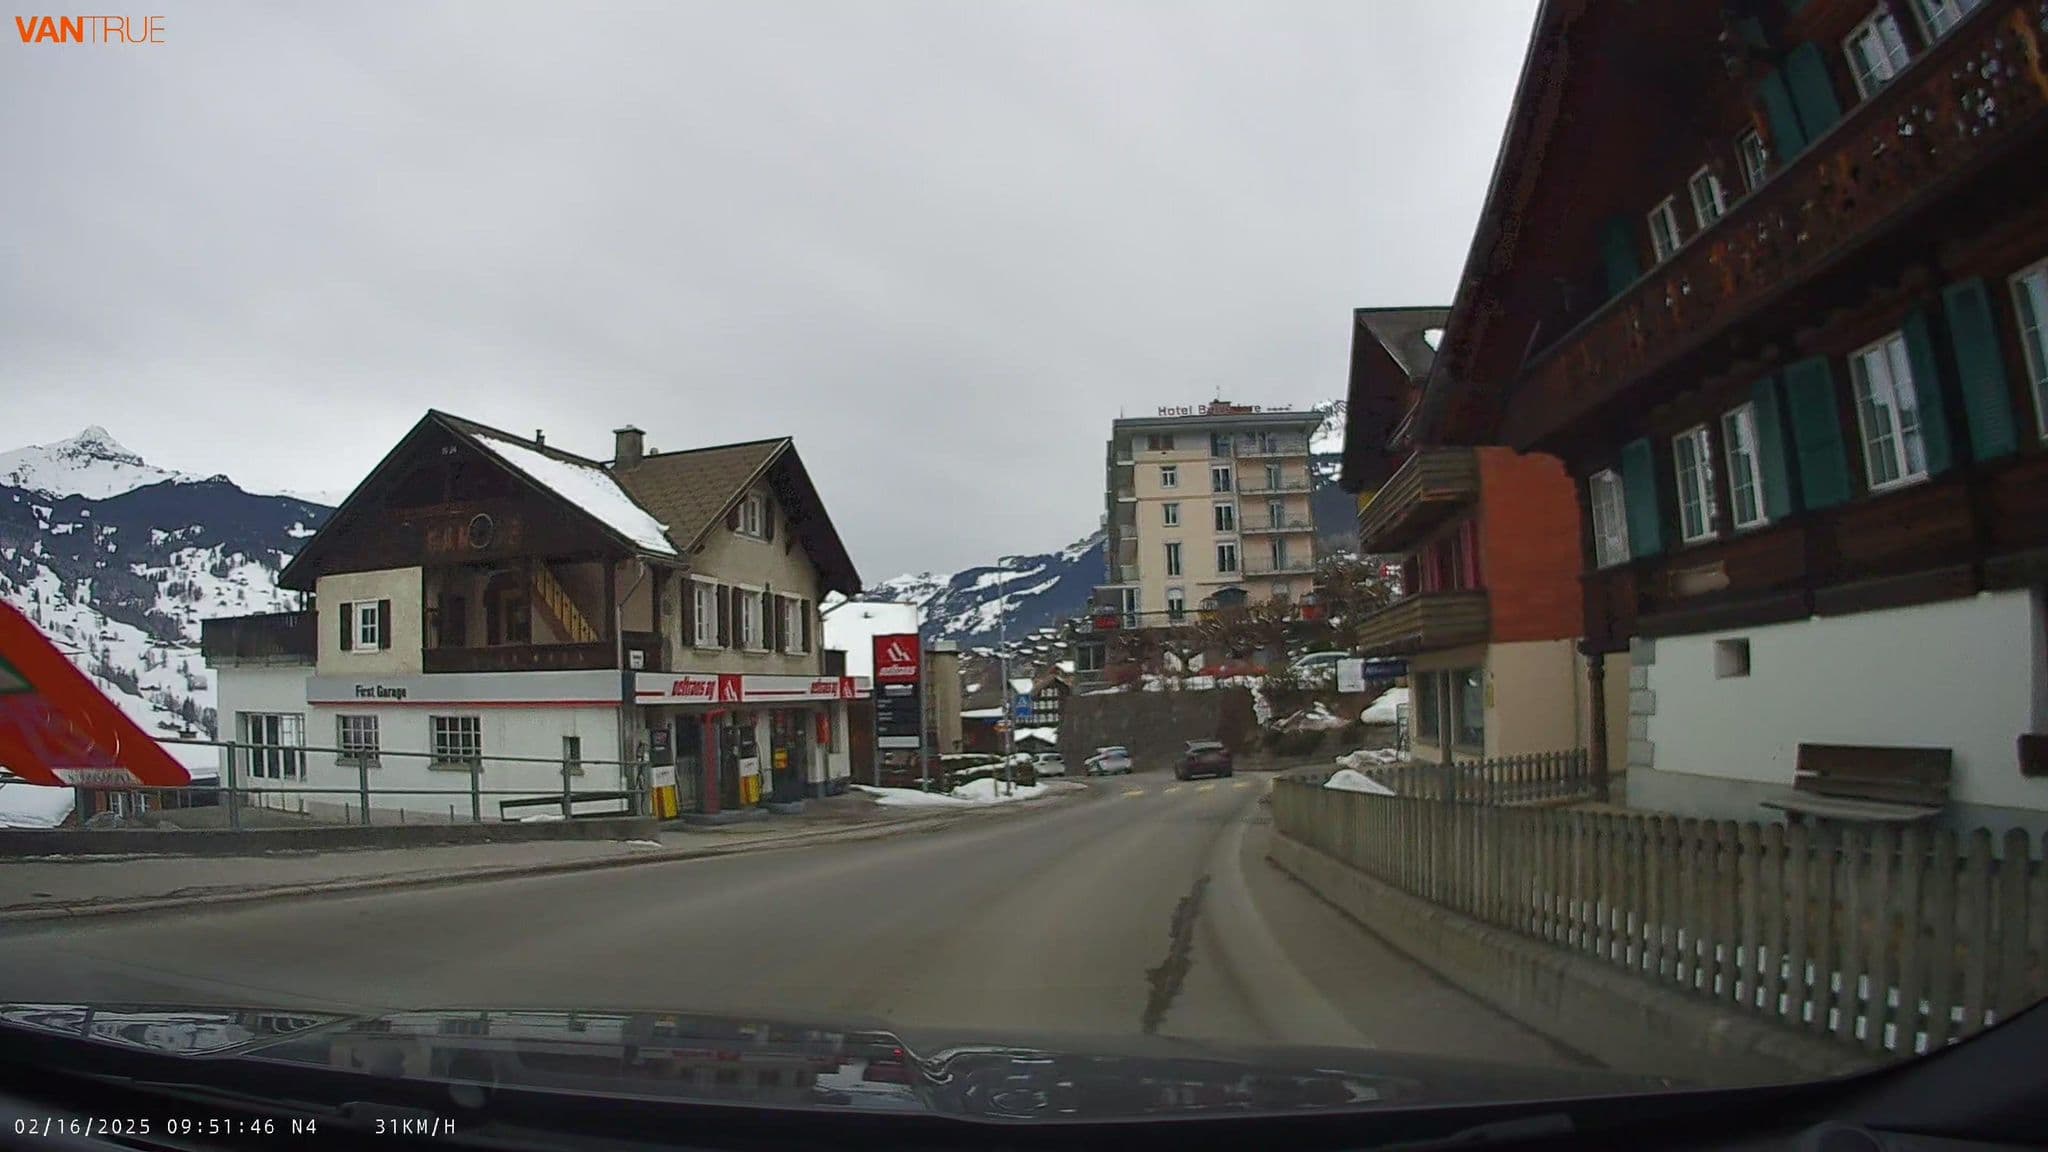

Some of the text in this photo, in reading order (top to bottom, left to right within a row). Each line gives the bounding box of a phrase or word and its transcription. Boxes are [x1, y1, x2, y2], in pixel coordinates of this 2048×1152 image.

[1158, 404, 1261, 417] Hotel Bedre
[355, 684, 407, 700] First Garage
